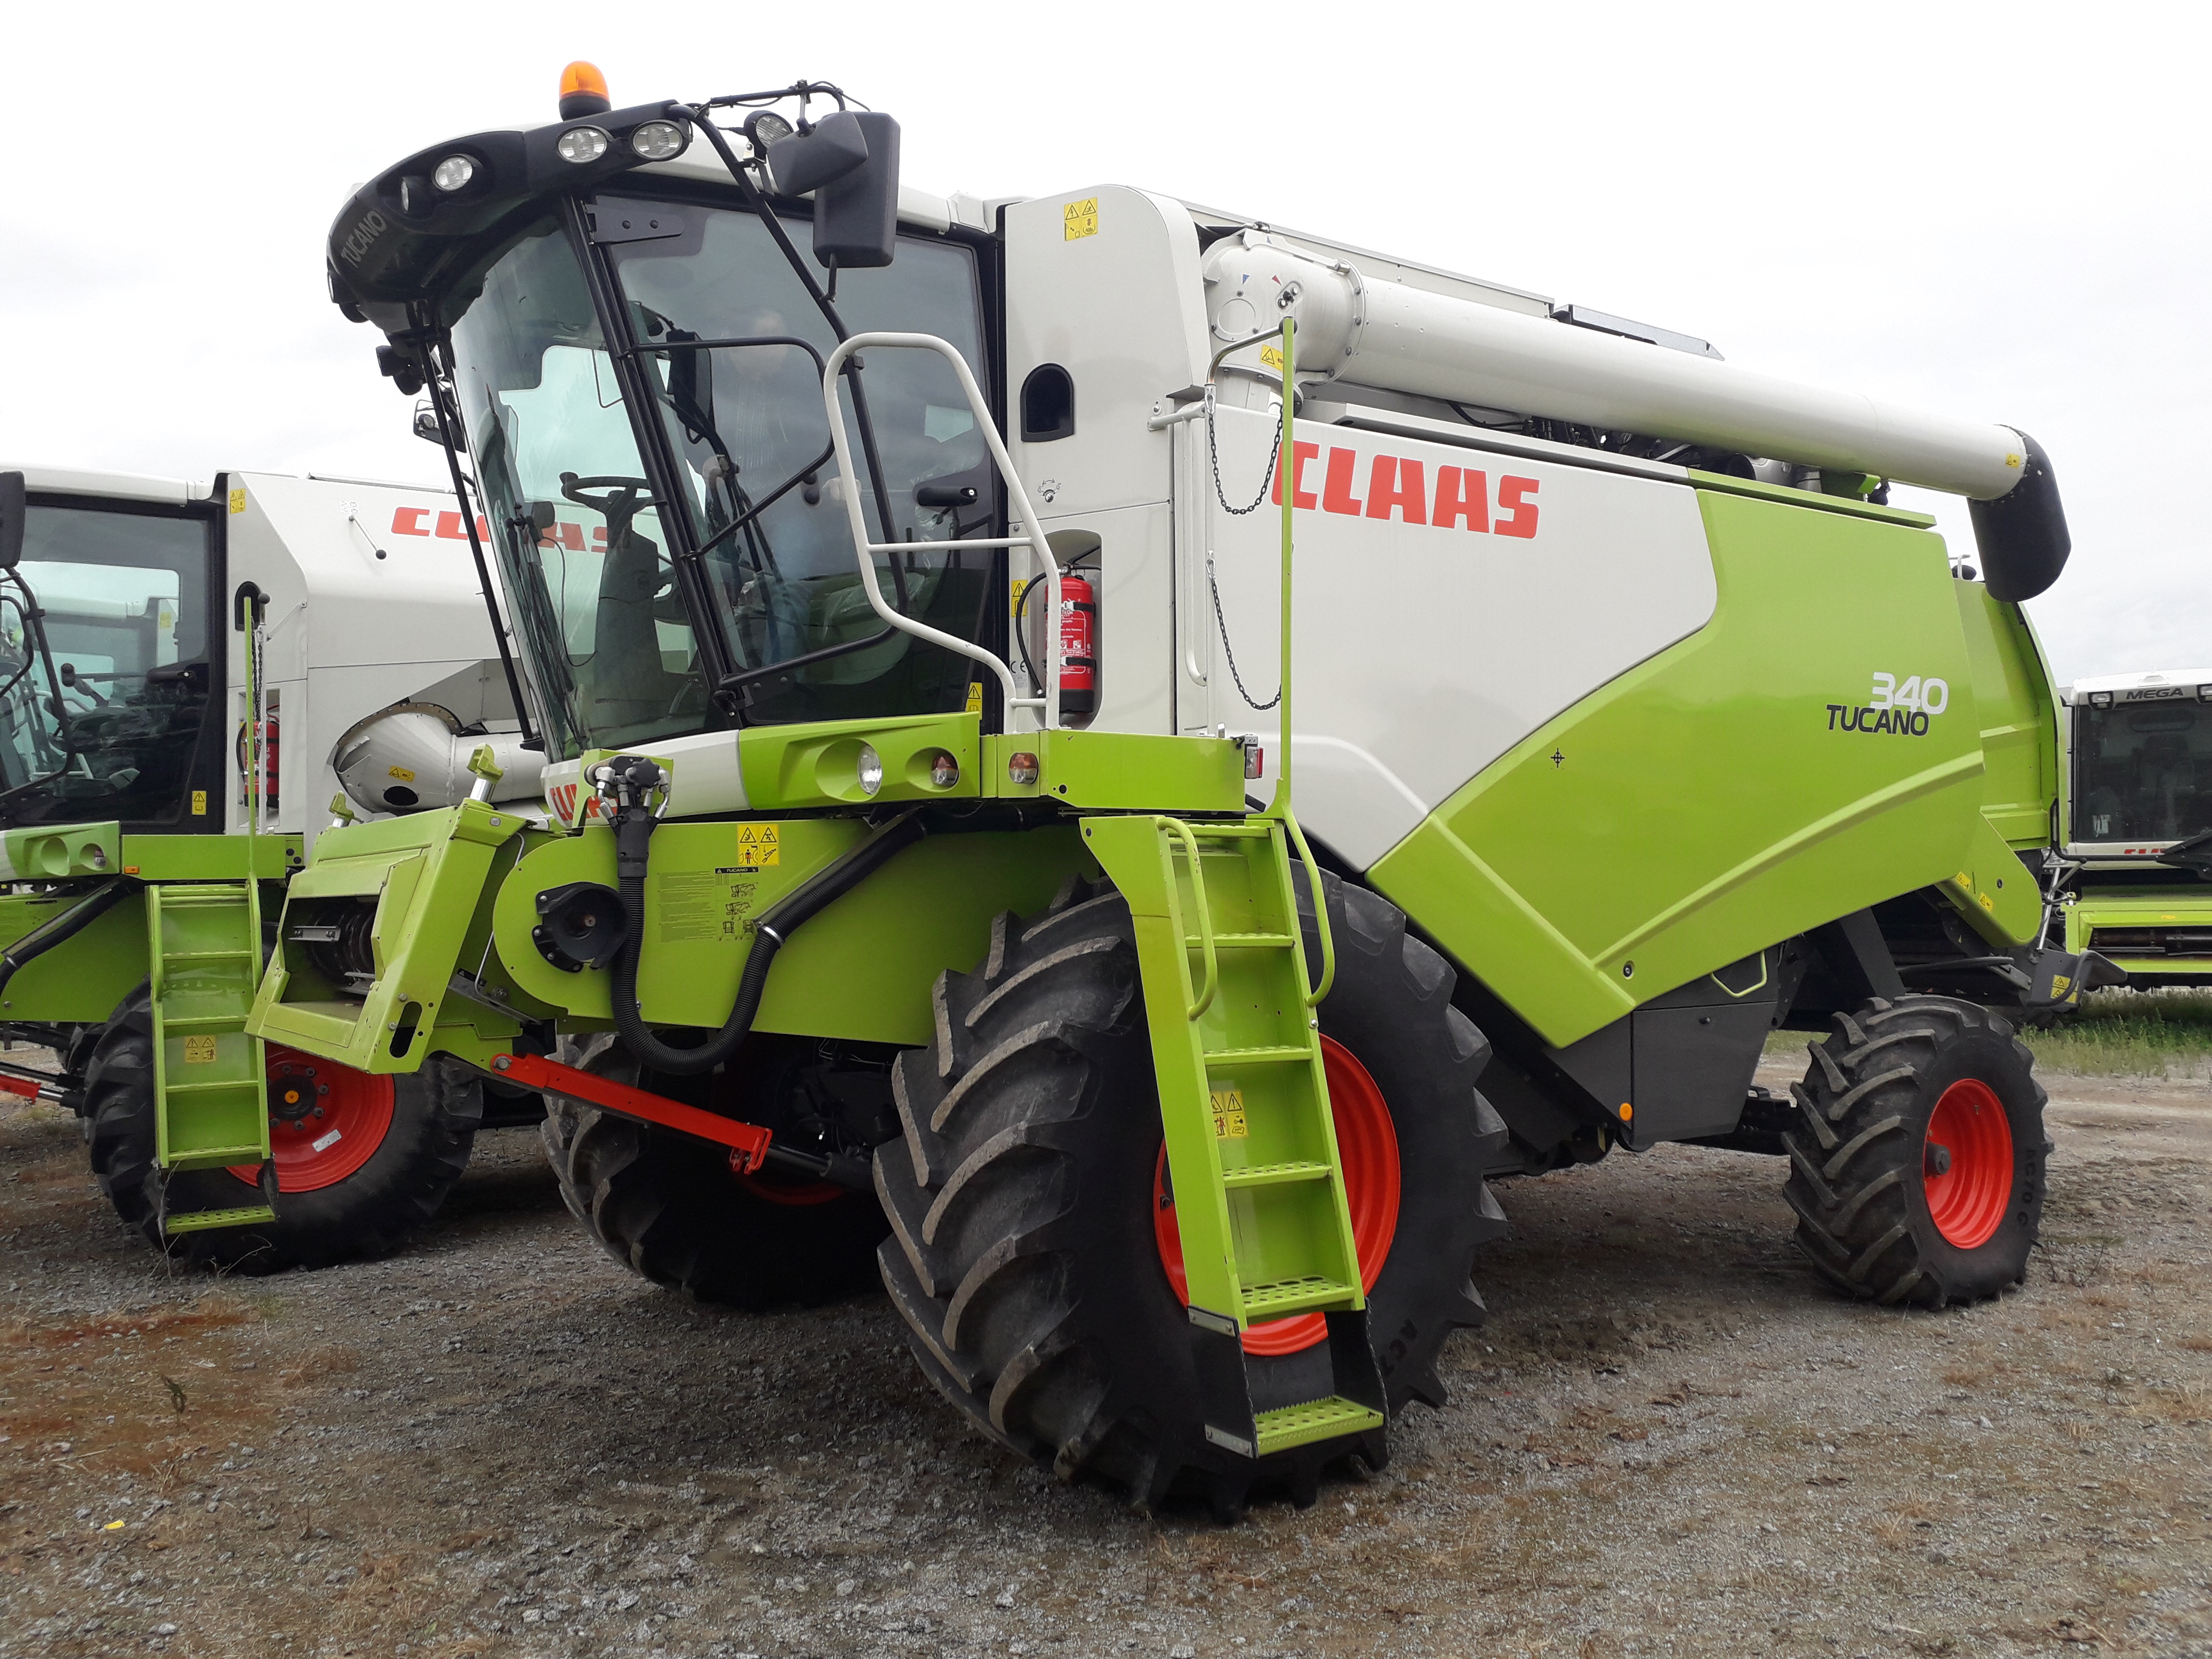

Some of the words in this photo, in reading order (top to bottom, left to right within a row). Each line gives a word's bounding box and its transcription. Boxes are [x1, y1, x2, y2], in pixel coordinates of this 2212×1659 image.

[341, 211, 386, 268] TUCANO
[1272, 440, 1540, 539] CLAAS
[1870, 671, 1949, 714] 340
[2126, 688, 2184, 700] MEGA
[1826, 704, 1929, 736] TUCANO
